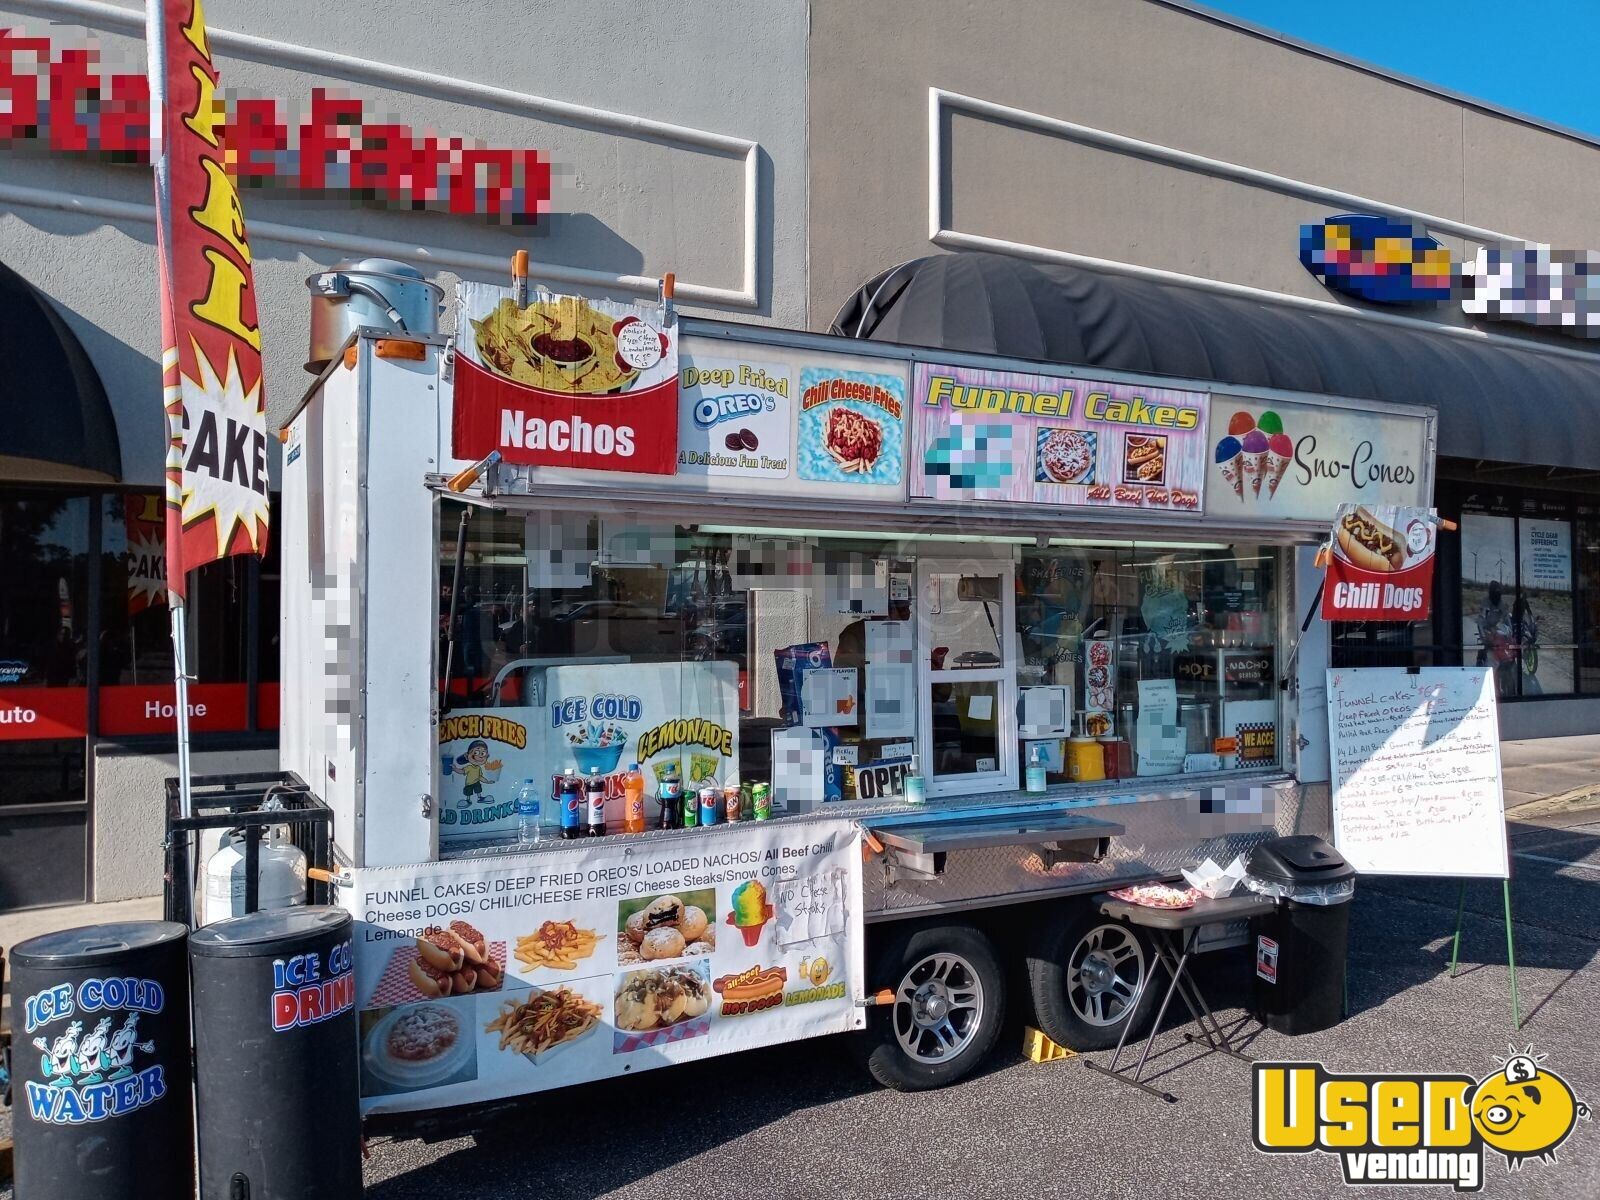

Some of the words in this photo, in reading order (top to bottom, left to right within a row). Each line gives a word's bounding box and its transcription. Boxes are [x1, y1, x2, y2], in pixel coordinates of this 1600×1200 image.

[683, 366, 735, 389] Deep
[739, 365, 789, 398] Fried
[802, 379, 831, 410] Chili
[830, 377, 873, 405] Cheese
[873, 384, 903, 419] Fries
[926, 375, 1074, 418] Funnel
[1084, 392, 1200, 430] Cakes
[501, 409, 635, 457] Nachos
[678, 450, 687, 464] A
[688, 451, 737, 467] Delicious
[739, 453, 758, 468] Fun
[761, 456, 788, 470] Treat
[1295, 435, 1415, 489] Sno-Cones
[1087, 485, 1111, 500] All
[1114, 486, 1143, 504] Beef
[1145, 488, 1168, 503] Hot
[1171, 489, 1199, 508] Dogs
[1333, 580, 1380, 610] Chili
[1383, 583, 1423, 612] Dogs
[1179, 663, 1213, 676] HOT
[1229, 660, 1269, 670] NACHO
[552, 696, 587, 728] ICE
[590, 693, 642, 722] COLD
[1337, 691, 1378, 709] FUNNEL
[480, 715, 527, 750] FRIES
[637, 717, 732, 764] LEMONADE
[1244, 732, 1256, 747] WE
[365, 887, 430, 905] FUNNEL
[434, 880, 492, 899] CAKES/
[495, 876, 535, 893] DEEP
[540, 871, 584, 888] FRIED
[587, 862, 642, 883] OREO'S/
[646, 857, 699, 875] LOADED
[703, 850, 762, 869] NACHOS/
[765, 848, 779, 861] All
[782, 846, 809, 859] Beef
[811, 841, 834, 856] Chili
[365, 908, 421, 925] Cheese
[425, 900, 475, 919] DOGS/
[479, 888, 582, 912] CHILI/CHEESE
[586, 881, 630, 900] FRIES/
[634, 877, 680, 893] Cheese
[684, 868, 758, 886] Steaks/Snow
[761, 863, 798, 879] Cones,
[780, 889, 794, 904] NO
[365, 923, 442, 943] Lemonade
[273, 953, 320, 989] ICE
[727, 965, 760, 989] all-beef
[25, 982, 74, 1033] ICE
[77, 977, 165, 1015] COLD
[722, 1001, 749, 1015] HOT
[748, 993, 783, 1013] DOGS
[785, 981, 846, 1007] LEMONADE
[25, 1064, 167, 1125] WATER
